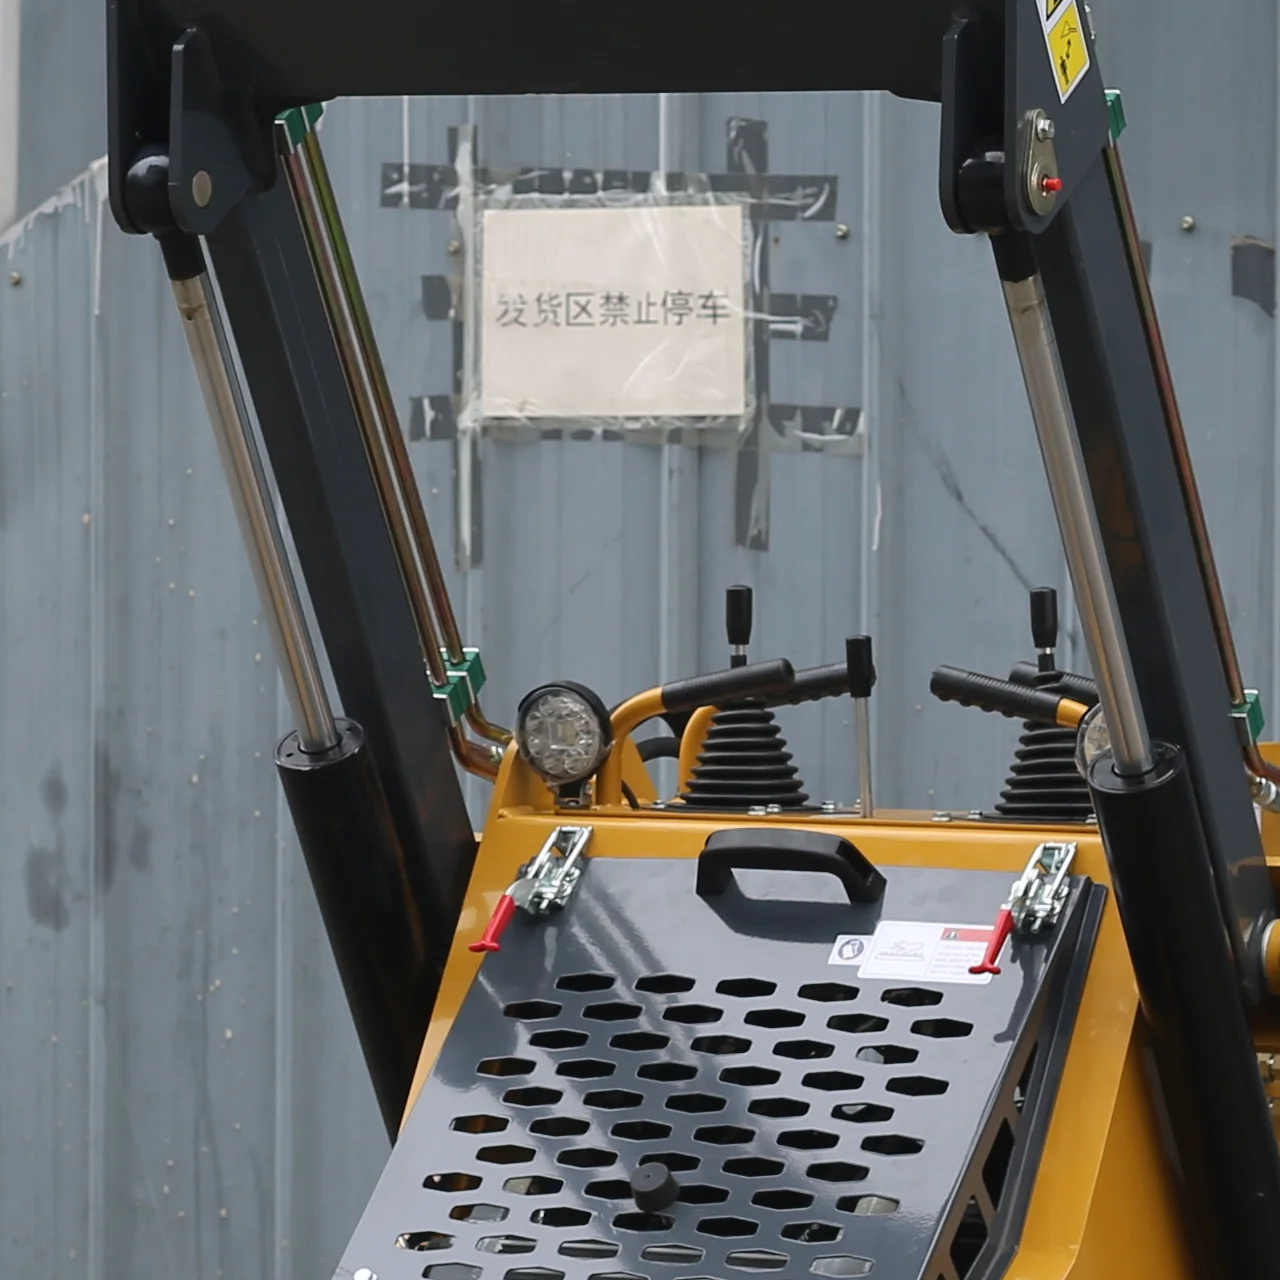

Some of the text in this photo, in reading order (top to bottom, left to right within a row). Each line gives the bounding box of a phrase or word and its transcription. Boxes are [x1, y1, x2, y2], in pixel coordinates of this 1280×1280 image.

[495, 289, 731, 328] 发货区禁止停车
